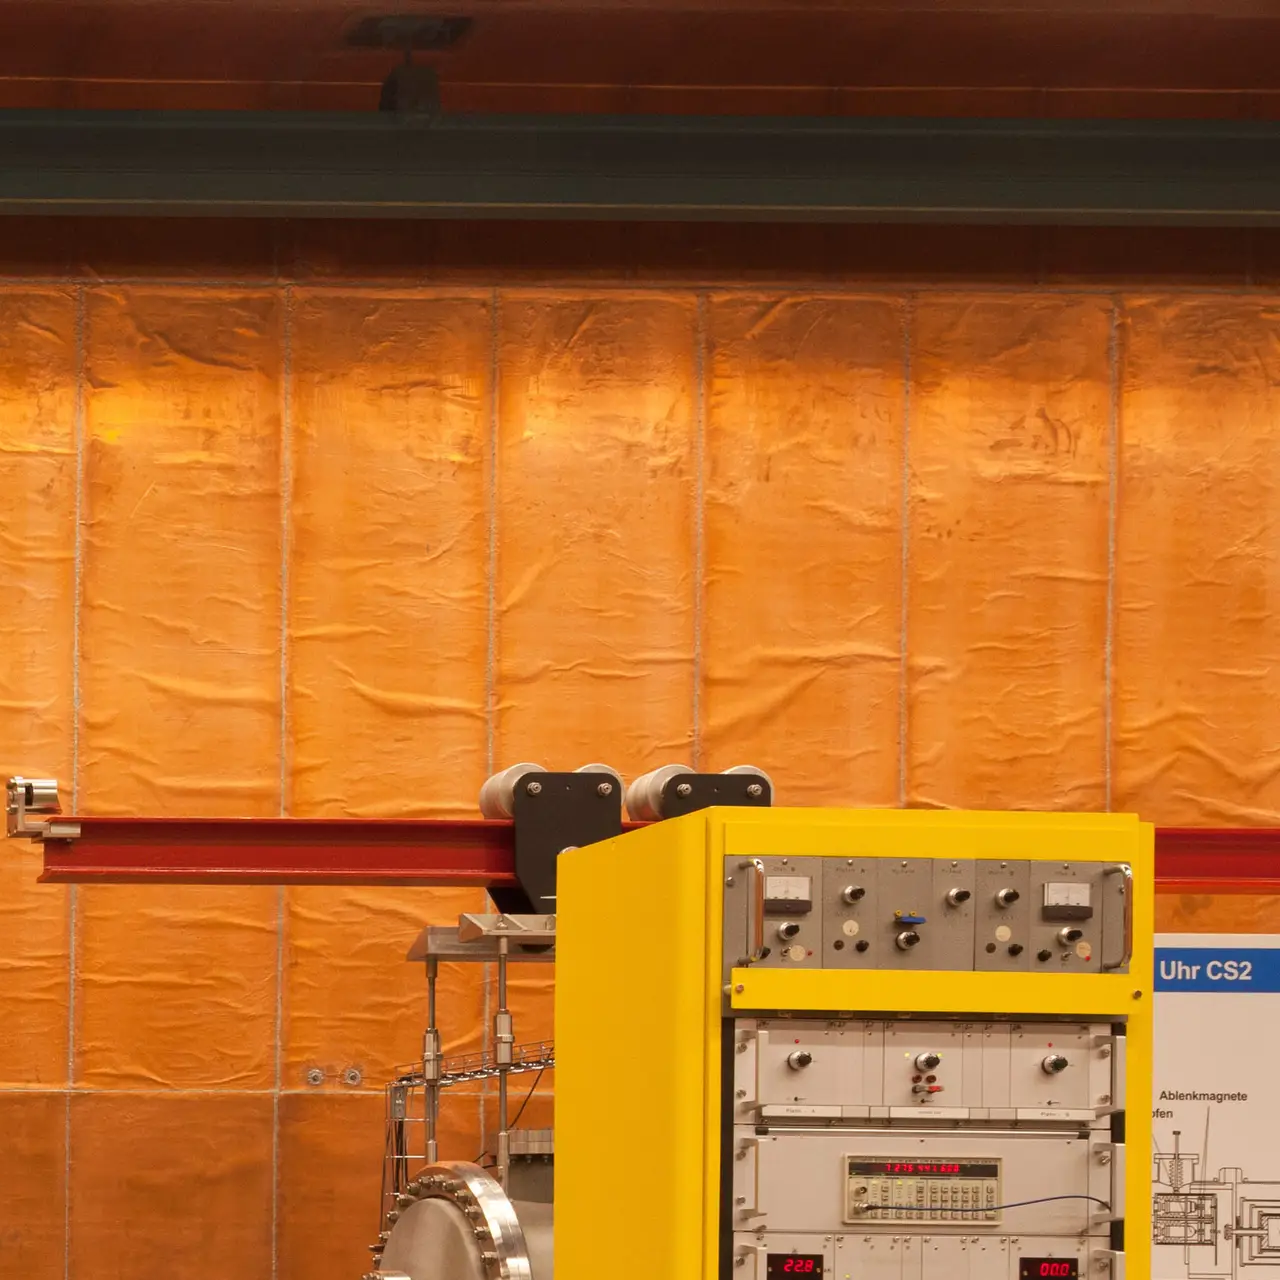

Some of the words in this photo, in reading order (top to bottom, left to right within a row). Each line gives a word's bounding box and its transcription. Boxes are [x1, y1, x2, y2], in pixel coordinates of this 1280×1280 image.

[1159, 960, 1201, 981] Uhr
[1206, 960, 1253, 981] CS2
[1159, 1091, 1248, 1104] Ablenkmagnete
